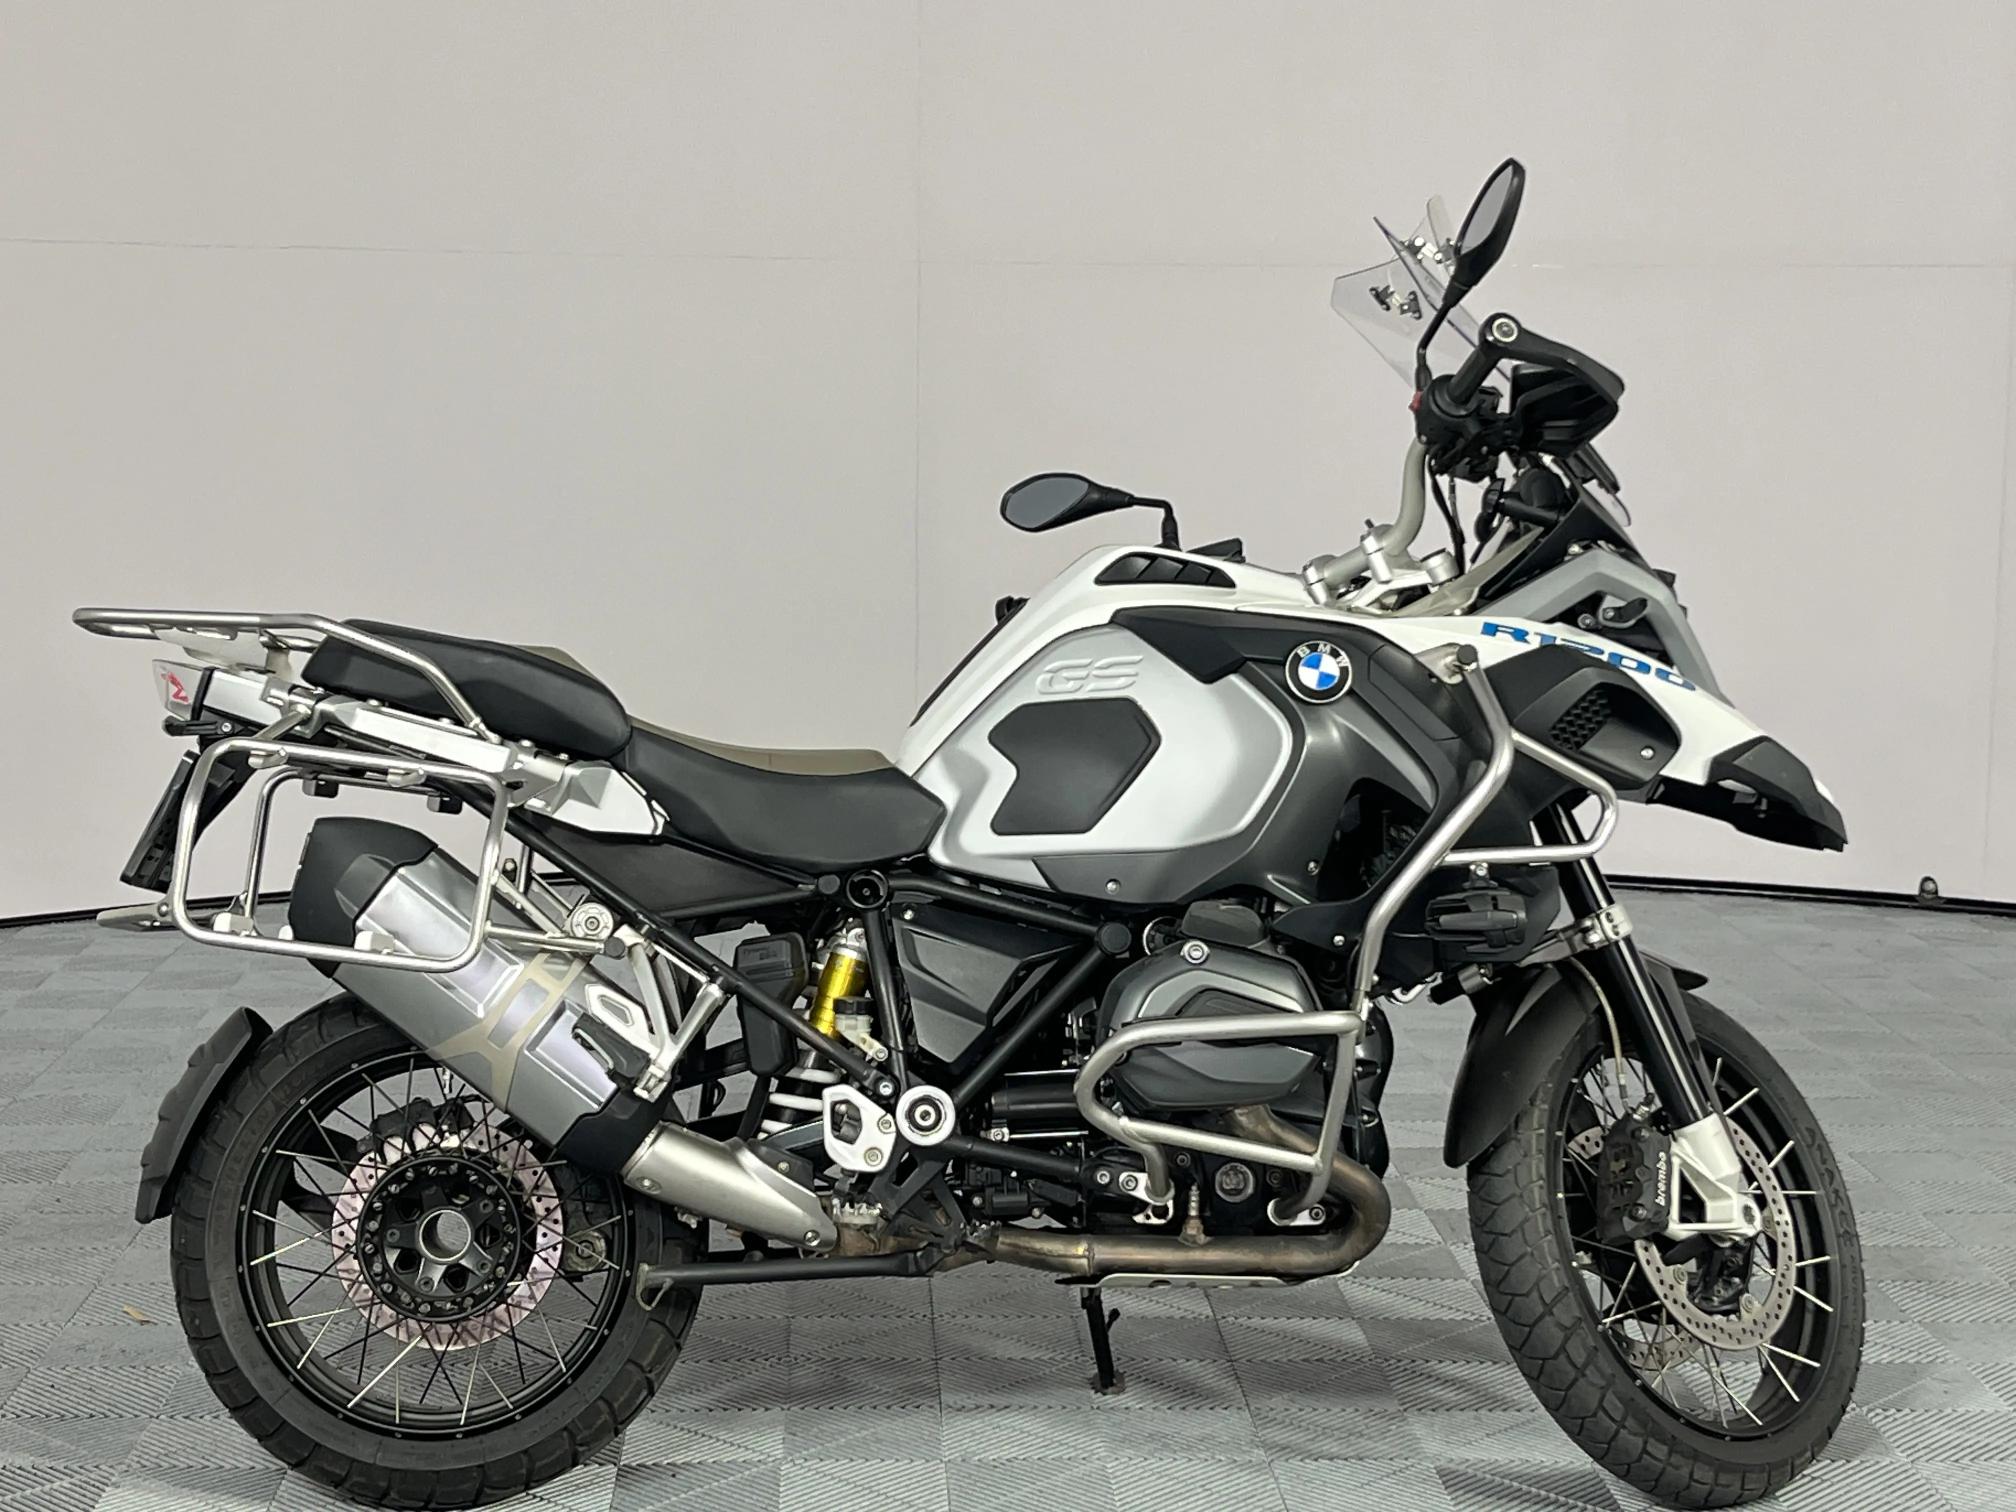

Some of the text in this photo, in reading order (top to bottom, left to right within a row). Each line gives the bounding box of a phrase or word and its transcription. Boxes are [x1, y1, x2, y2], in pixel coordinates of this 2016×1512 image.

[1036, 655, 1144, 695] GS
[1296, 643, 1350, 667] BMW
[1655, 1151, 1667, 1206] brembo
